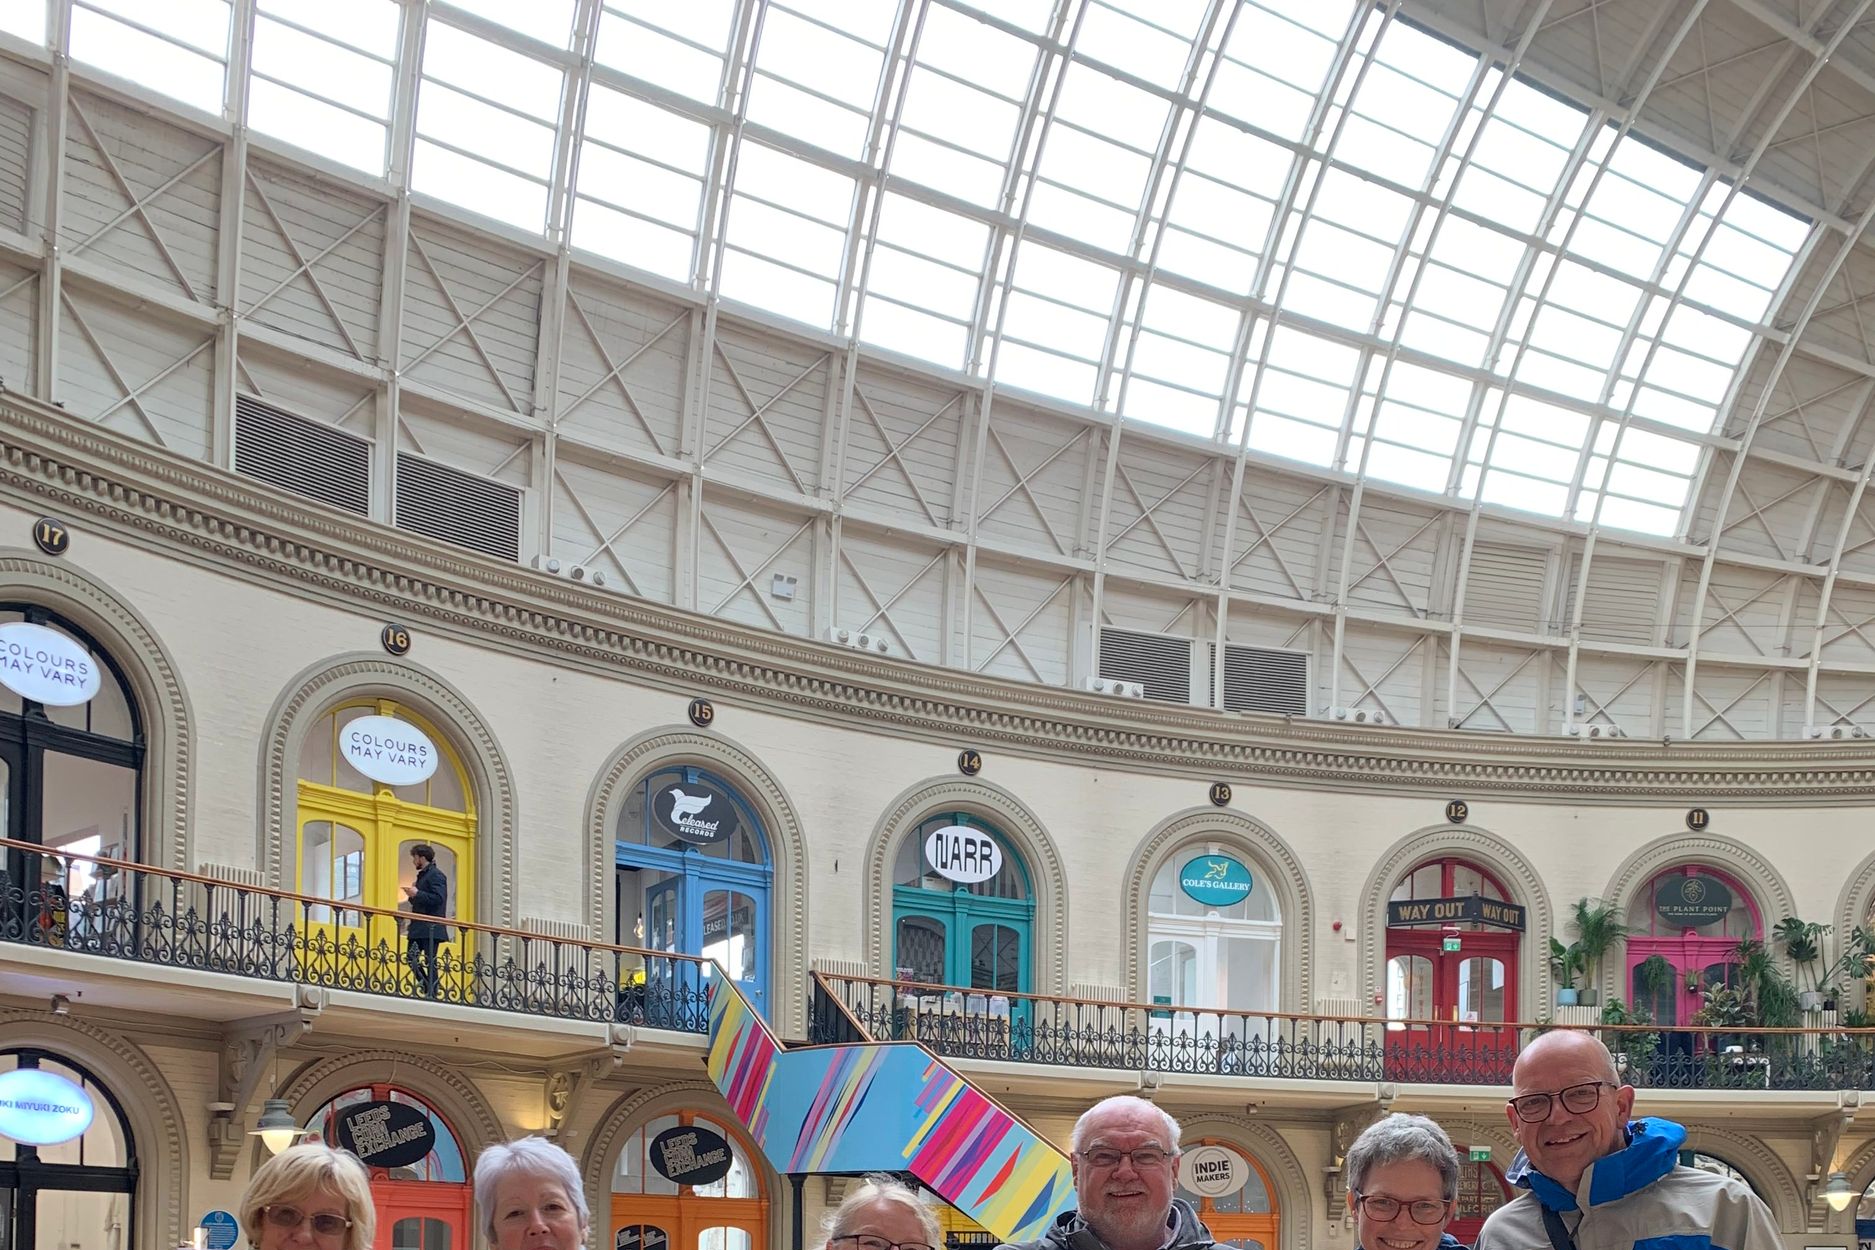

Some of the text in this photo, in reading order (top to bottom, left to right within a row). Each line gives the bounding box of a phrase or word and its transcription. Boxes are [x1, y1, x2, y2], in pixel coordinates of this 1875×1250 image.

[42, 523, 64, 546] 17
[387, 628, 407, 649] 16
[41, 667, 87, 690] VARY
[694, 703, 711, 720] 15
[351, 731, 427, 757] COLOURS
[351, 745, 426, 769] MAY VARY
[963, 753, 981, 769] 14
[1215, 786, 1230, 800] 13
[1450, 804, 1466, 817] 12
[1693, 811, 1704, 824] 11
[679, 827, 714, 838] RECORDS
[935, 833, 993, 876] NARR
[1182, 877, 1250, 892] COLE'S GALLERY
[1399, 902, 1464, 920] WAY OUT
[1482, 903, 1520, 924] WAY OUT
[15, 1101, 50, 1113] MIYUKI
[52, 1104, 80, 1115] ZOKU
[346, 1105, 391, 1131] LEEDS
[351, 1121, 390, 1145] CORN
[356, 1121, 427, 1159] EXCHANGE
[659, 1132, 698, 1154] LEEDS
[663, 1146, 695, 1167] CORN
[667, 1148, 727, 1178] EXCHANGE
[1194, 1160, 1230, 1175] INDIE
[1196, 1172, 1231, 1184] MAKERS
